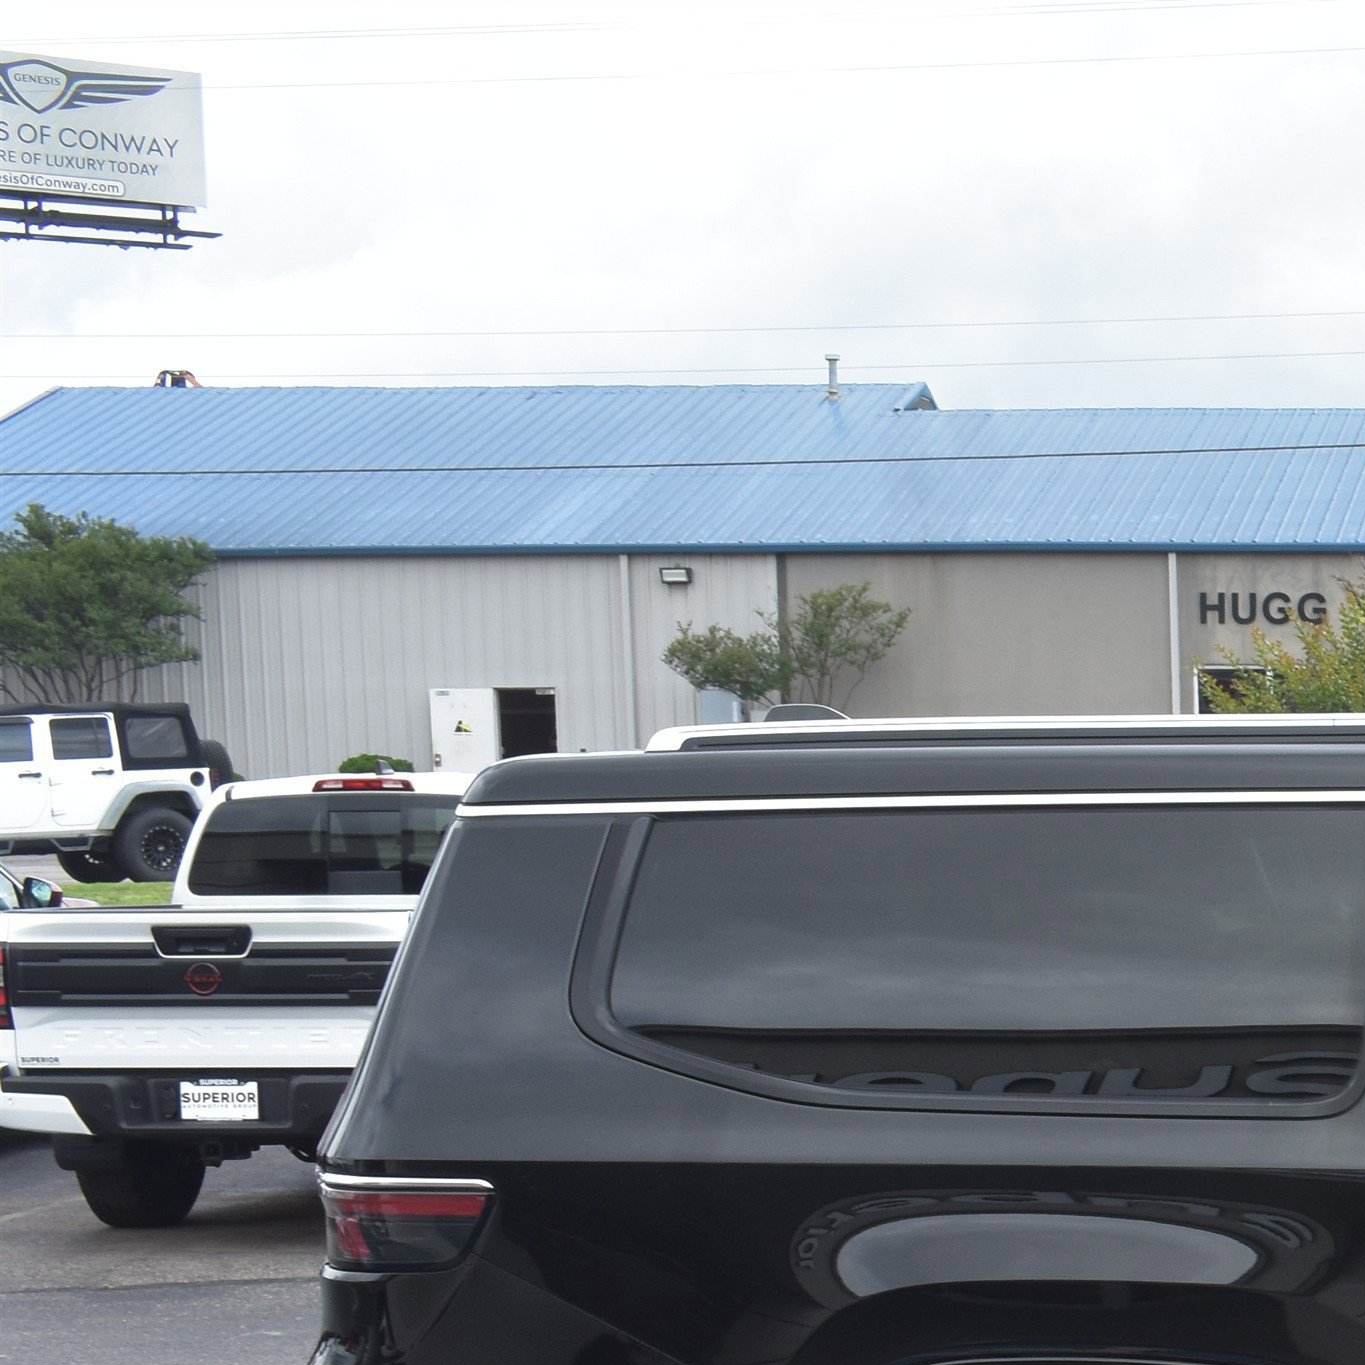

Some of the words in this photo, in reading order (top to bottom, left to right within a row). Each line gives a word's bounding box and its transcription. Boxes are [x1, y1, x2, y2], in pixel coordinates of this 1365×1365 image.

[14, 72, 61, 86] GENESIS
[17, 123, 51, 145] OF
[59, 127, 179, 158] CONWAY
[21, 151, 42, 165] OF
[46, 153, 105, 171] LUXURY
[109, 159, 159, 176] TODAY
[1199, 591, 1328, 625] HUGG
[199, 1079, 239, 1087] SUPERIOR
[182, 1092, 257, 1104] SUPERIOR
